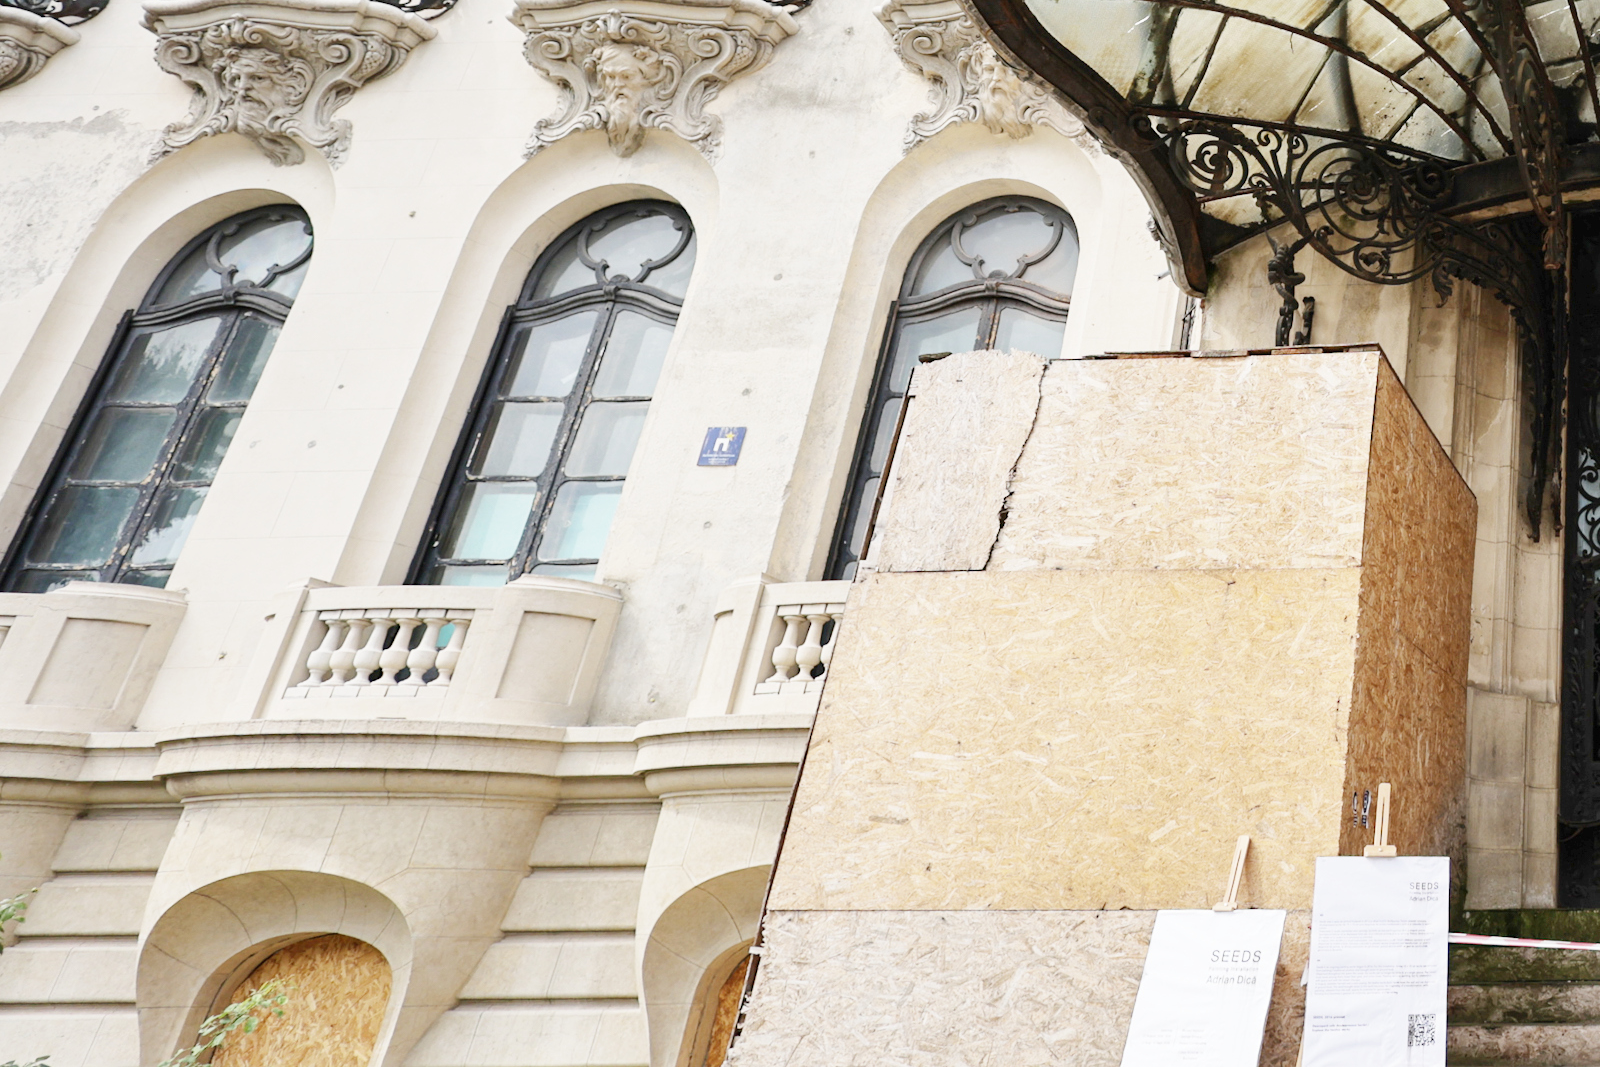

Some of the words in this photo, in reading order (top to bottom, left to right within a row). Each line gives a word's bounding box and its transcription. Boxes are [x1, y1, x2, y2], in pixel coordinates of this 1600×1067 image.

[1409, 881, 1439, 891] SEEDS
[1210, 949, 1262, 963] SEEDS
[1206, 975, 1235, 985] Adrian
